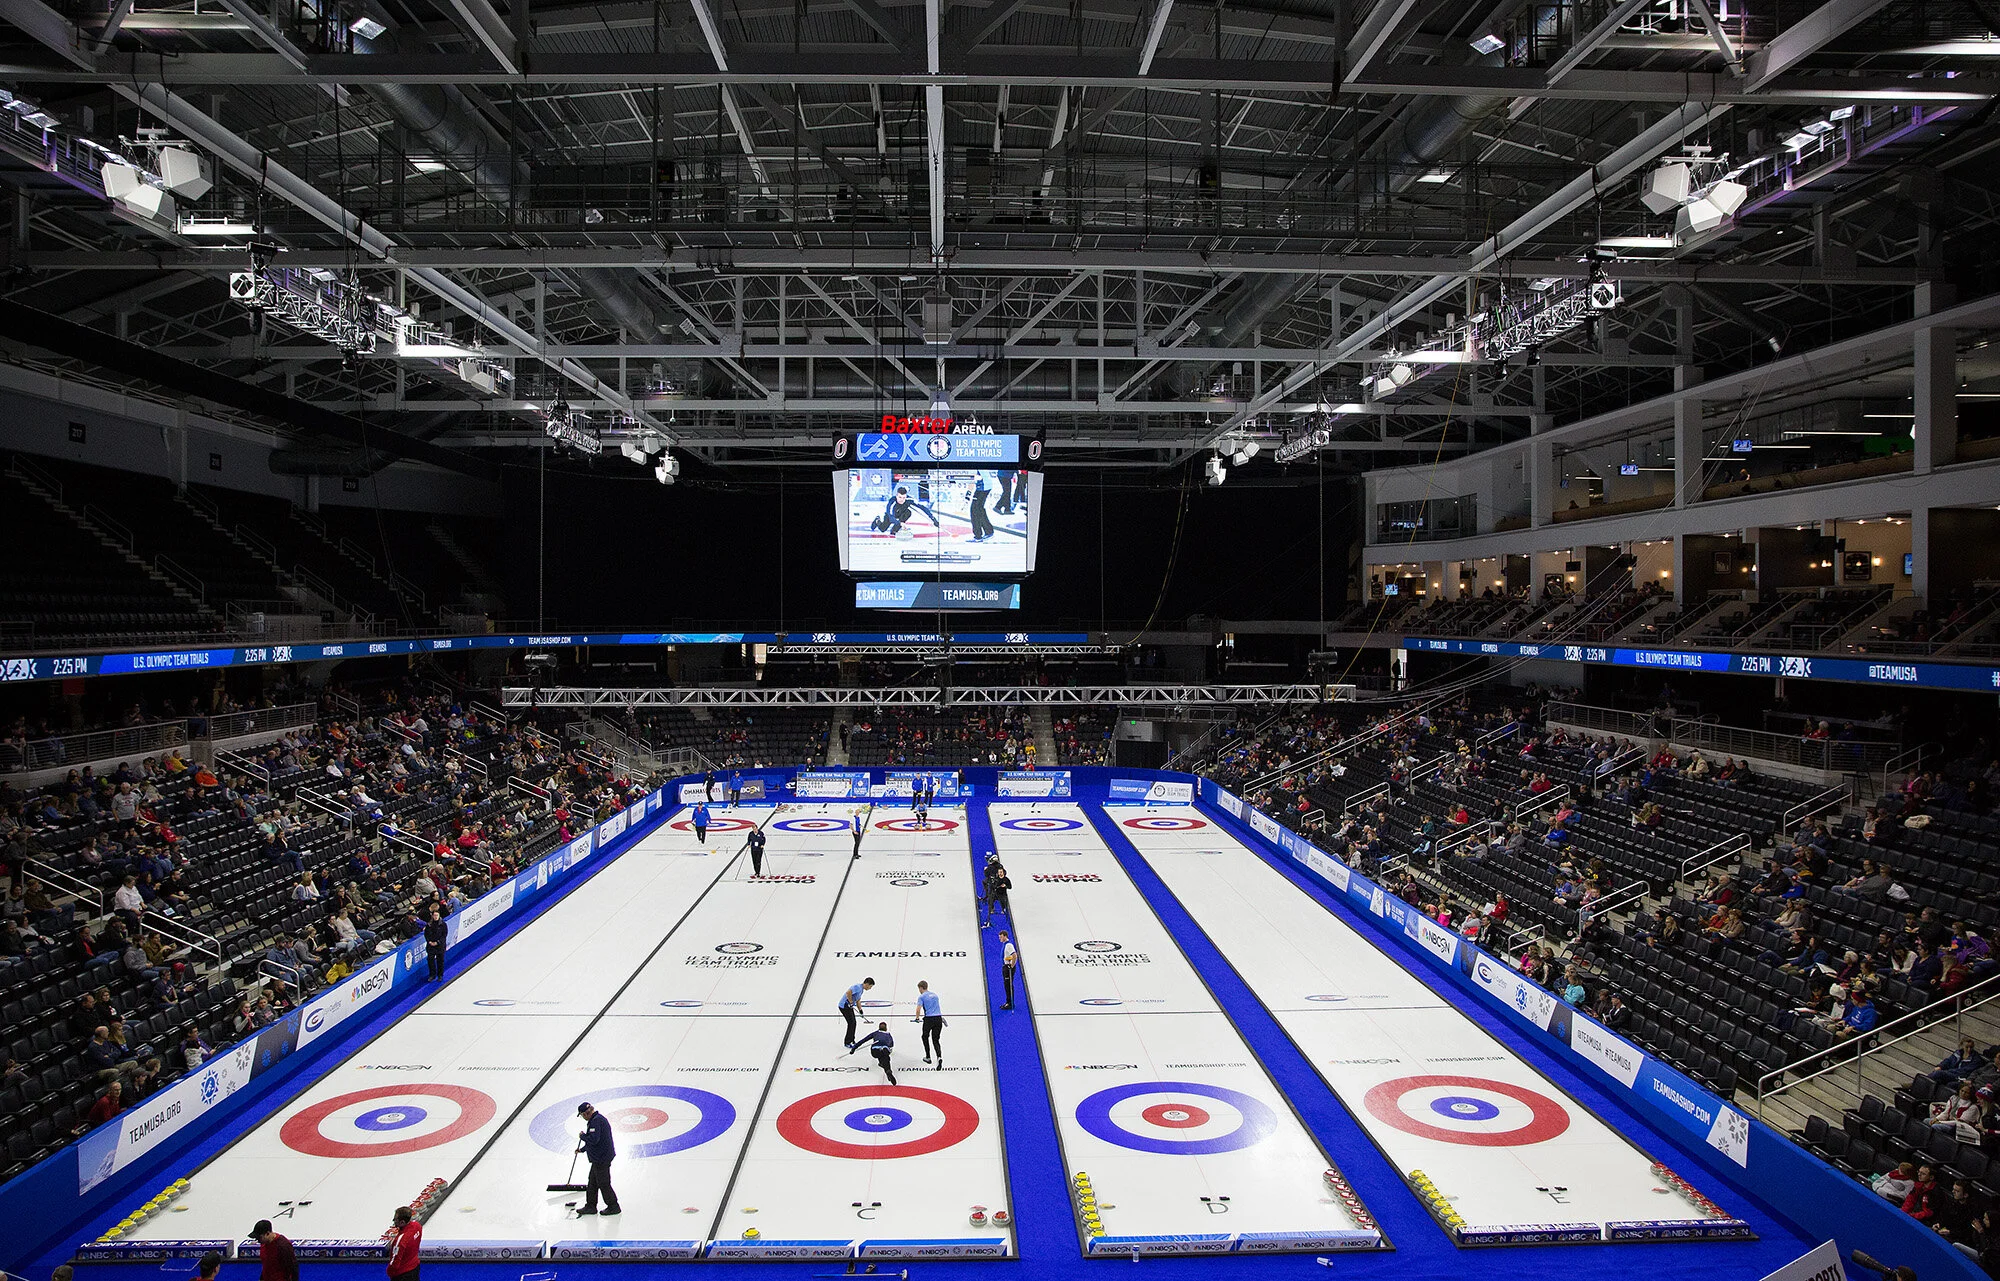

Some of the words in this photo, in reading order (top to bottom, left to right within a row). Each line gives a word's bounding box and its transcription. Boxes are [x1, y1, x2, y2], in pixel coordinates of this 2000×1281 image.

[881, 415, 953, 434] Baxter
[953, 425, 994, 435] ARENA
[956, 440, 970, 449] U.S.
[972, 440, 1002, 449] OLYMPIC
[956, 449, 974, 458] TEAM
[977, 449, 1002, 458] TRIALS
[864, 590, 876, 600] TEAM
[878, 589, 904, 600] TRIALS
[943, 589, 998, 600] TEAMUSA.ORG
[897, 634, 920, 642] OLYMPIC
[921, 634, 935, 642] TEAM
[133, 657, 144, 668] U.S.
[147, 655, 172, 668] OLYMPIC
[174, 654, 188, 666] TEAM
[189, 653, 208, 665] TRIALS
[245, 650, 257, 662] 2:25
[258, 649, 266, 660] PM
[1586, 649, 1597, 661] 2:25
[1598, 649, 1606, 661] PM
[1635, 652, 1644, 663] U.S.
[1645, 652, 1666, 665] OLYMPIC
[1667, 654, 1682, 666] TEAM
[1682, 654, 1702, 667] TRIALS
[53, 658, 73, 675] 2:25
[75, 657, 87, 673] PM
[1741, 656, 1758, 671] 2:25
[1759, 657, 1771, 672] PM
[1868, 665, 1918, 681] @TEAMUSA
[1428, 931, 1450, 954] NBCSN
[360, 967, 389, 996] NBCSN
[1577, 1029, 1602, 1051] @TEAMUSA
[1604, 1047, 1632, 1073] #TEAMUSA
[1653, 1078, 1711, 1126] TEAMUSASHOP.COM
[129, 1099, 182, 1145] TEAMUSA.ORG
[273, 1207, 295, 1219] A
[857, 1208, 876, 1220] C
[1206, 1203, 1229, 1214] D
[926, 1248, 949, 1256] NBCSN
